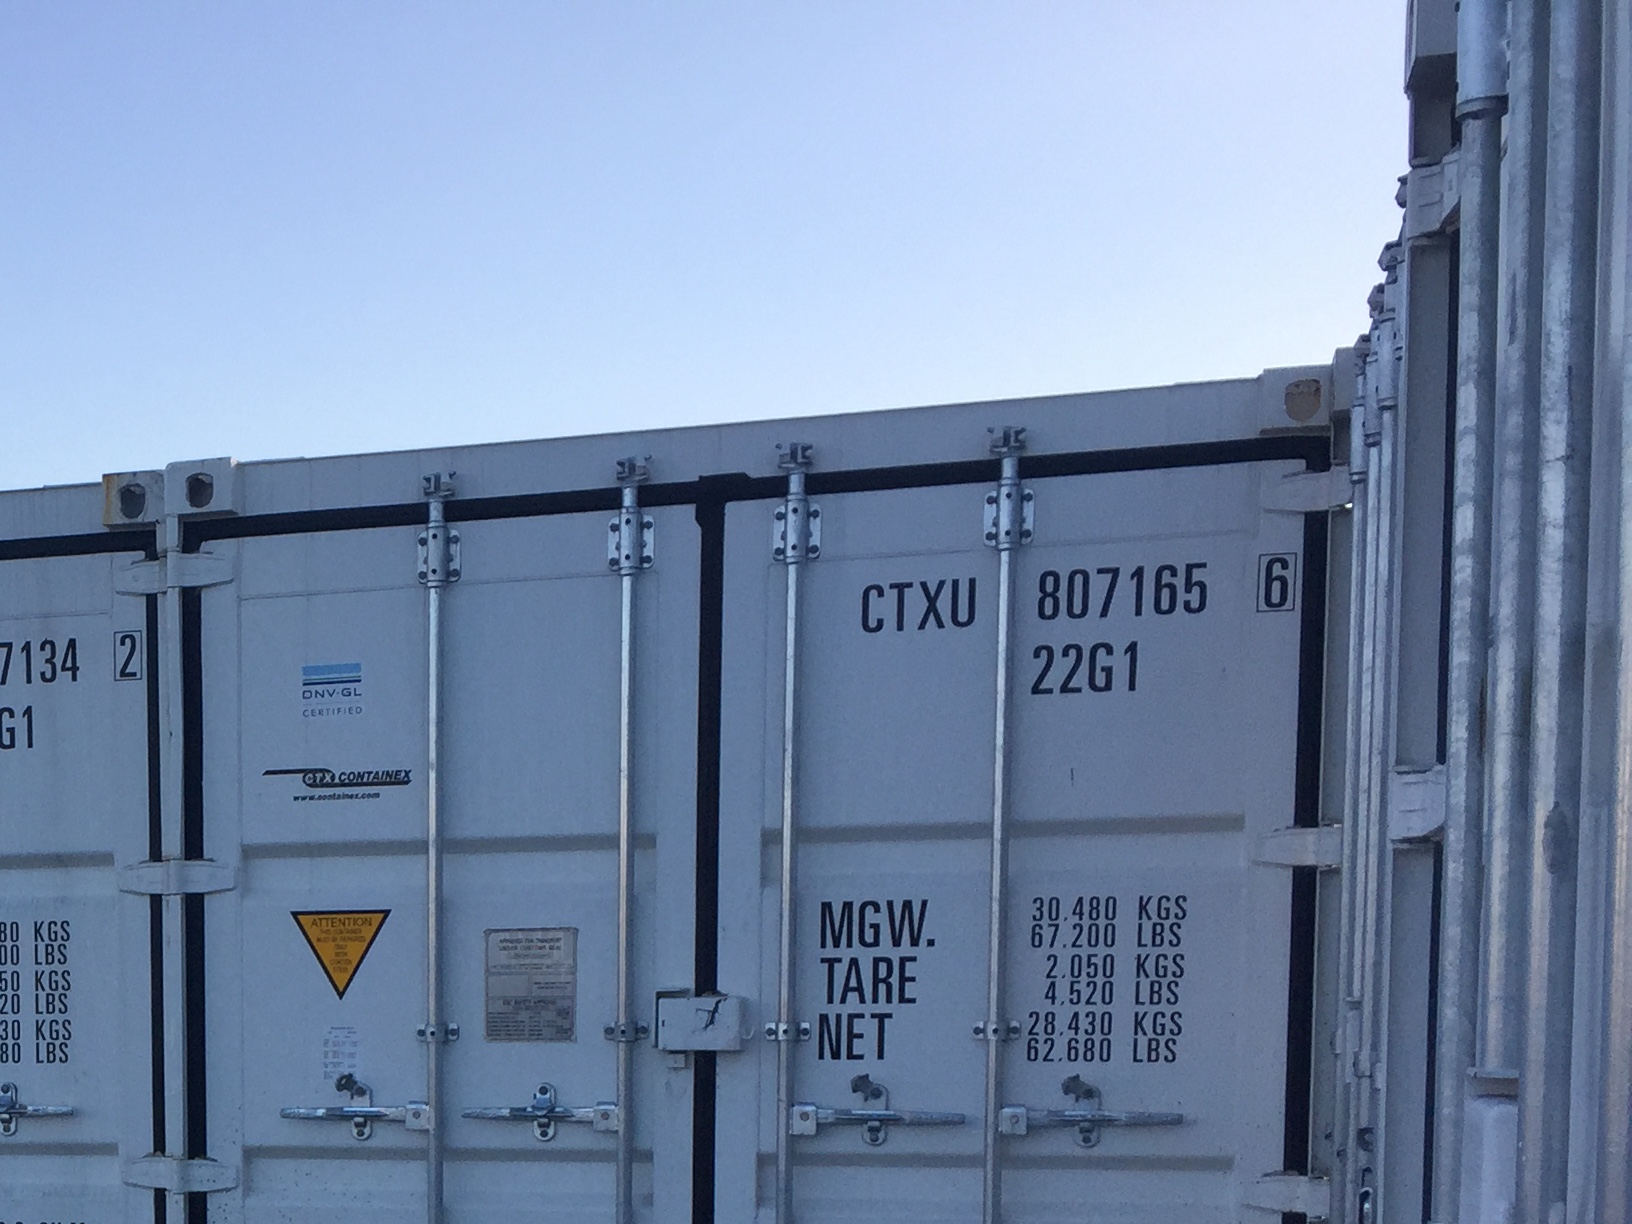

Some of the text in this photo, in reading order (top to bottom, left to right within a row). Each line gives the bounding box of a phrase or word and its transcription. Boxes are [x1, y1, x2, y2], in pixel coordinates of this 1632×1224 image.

[861, 556, 1289, 634] CTXU 807165 6
[119, 633, 137, 678] 2
[1030, 640, 1138, 696] 22G1
[302, 706, 363, 718] CERTIFIED
[338, 769, 413, 783] CONTAINEX
[1032, 895, 1188, 922] 30.480 KGS
[33, 920, 71, 943] KGS
[310, 916, 373, 929] ATTENTION
[820, 899, 936, 949] MGW.
[1030, 921, 1182, 949] 67.200 LBS
[34, 943, 68, 966] LBS
[1045, 953, 1185, 979] 2.050 KGS
[34, 969, 71, 992] KGS
[819, 955, 918, 1005] TARE
[1044, 979, 1179, 1006] 4.520 LBS
[34, 991, 69, 1015] LBS
[35, 1018, 72, 1041] KGS
[817, 1012, 893, 1061] NET
[1027, 1010, 1183, 1038] 28.430 KGS
[35, 1041, 69, 1064] LBS
[1026, 1037, 1177, 1063] 62.680 LBS
